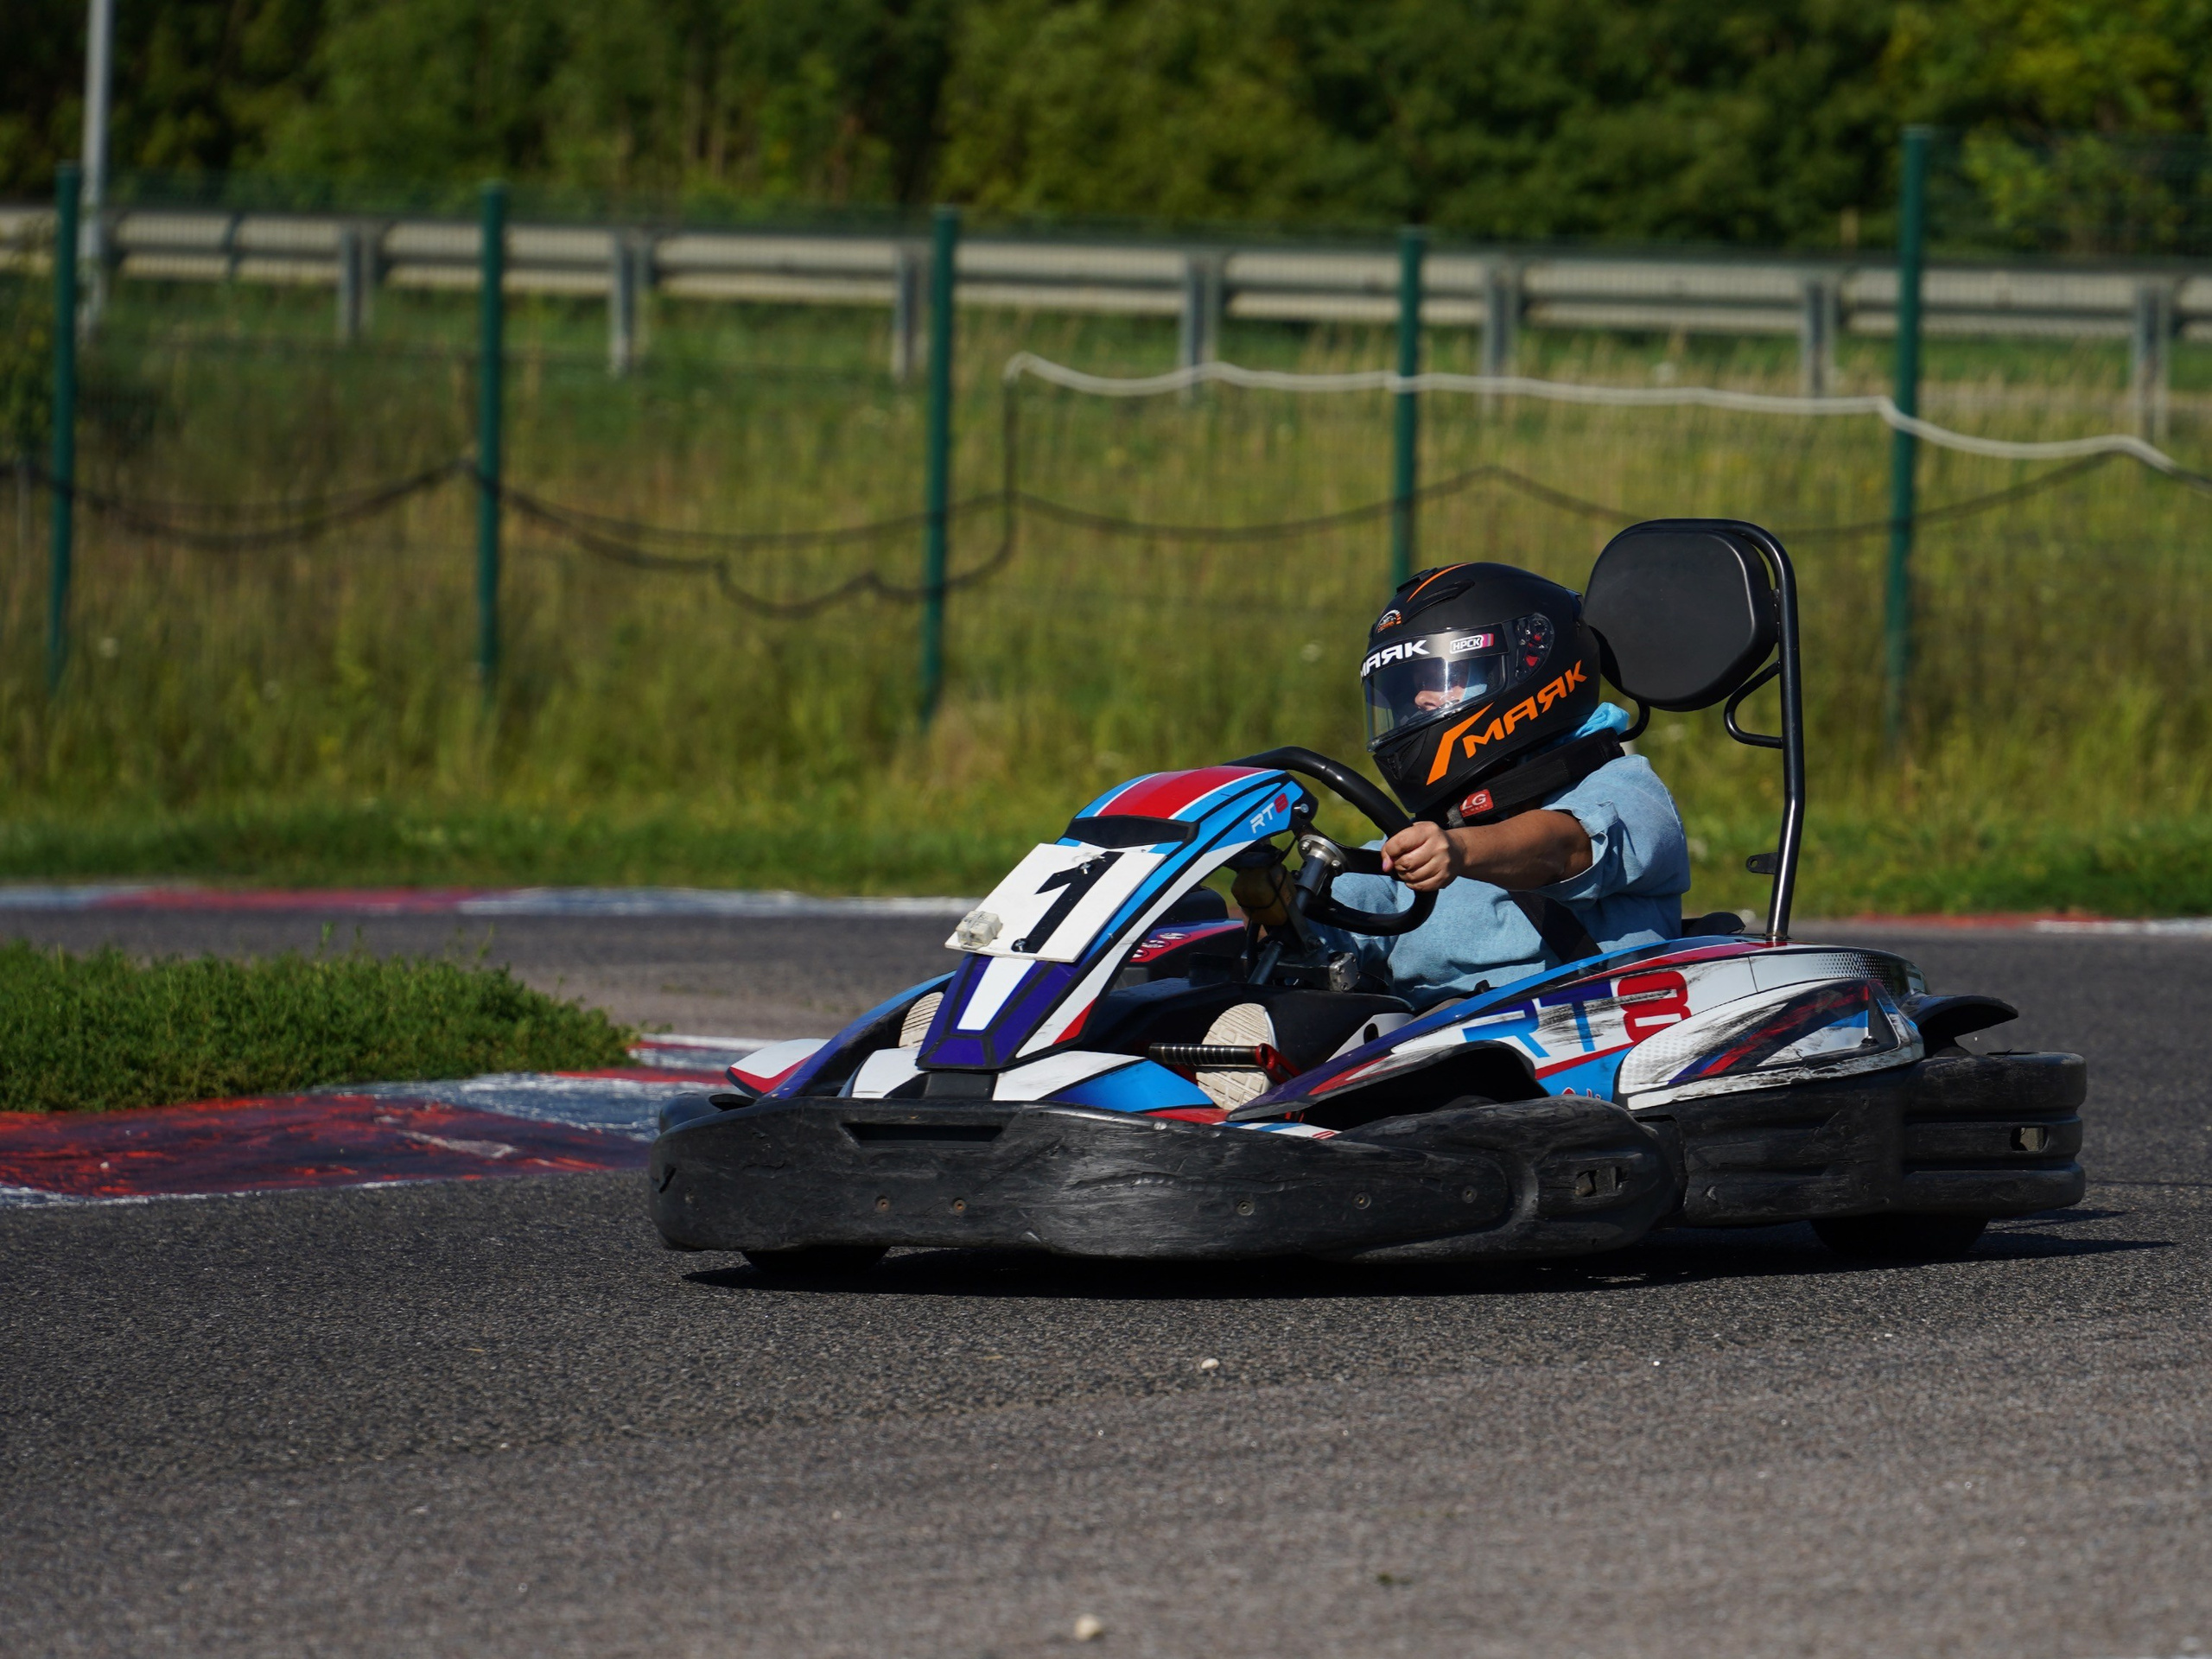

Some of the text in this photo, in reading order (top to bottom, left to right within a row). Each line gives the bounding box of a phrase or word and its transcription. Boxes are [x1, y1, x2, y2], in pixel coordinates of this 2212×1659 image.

[1249, 792, 1289, 834] RT8
[1023, 850, 1126, 954] 1
[1462, 970, 1692, 1058] RT8
